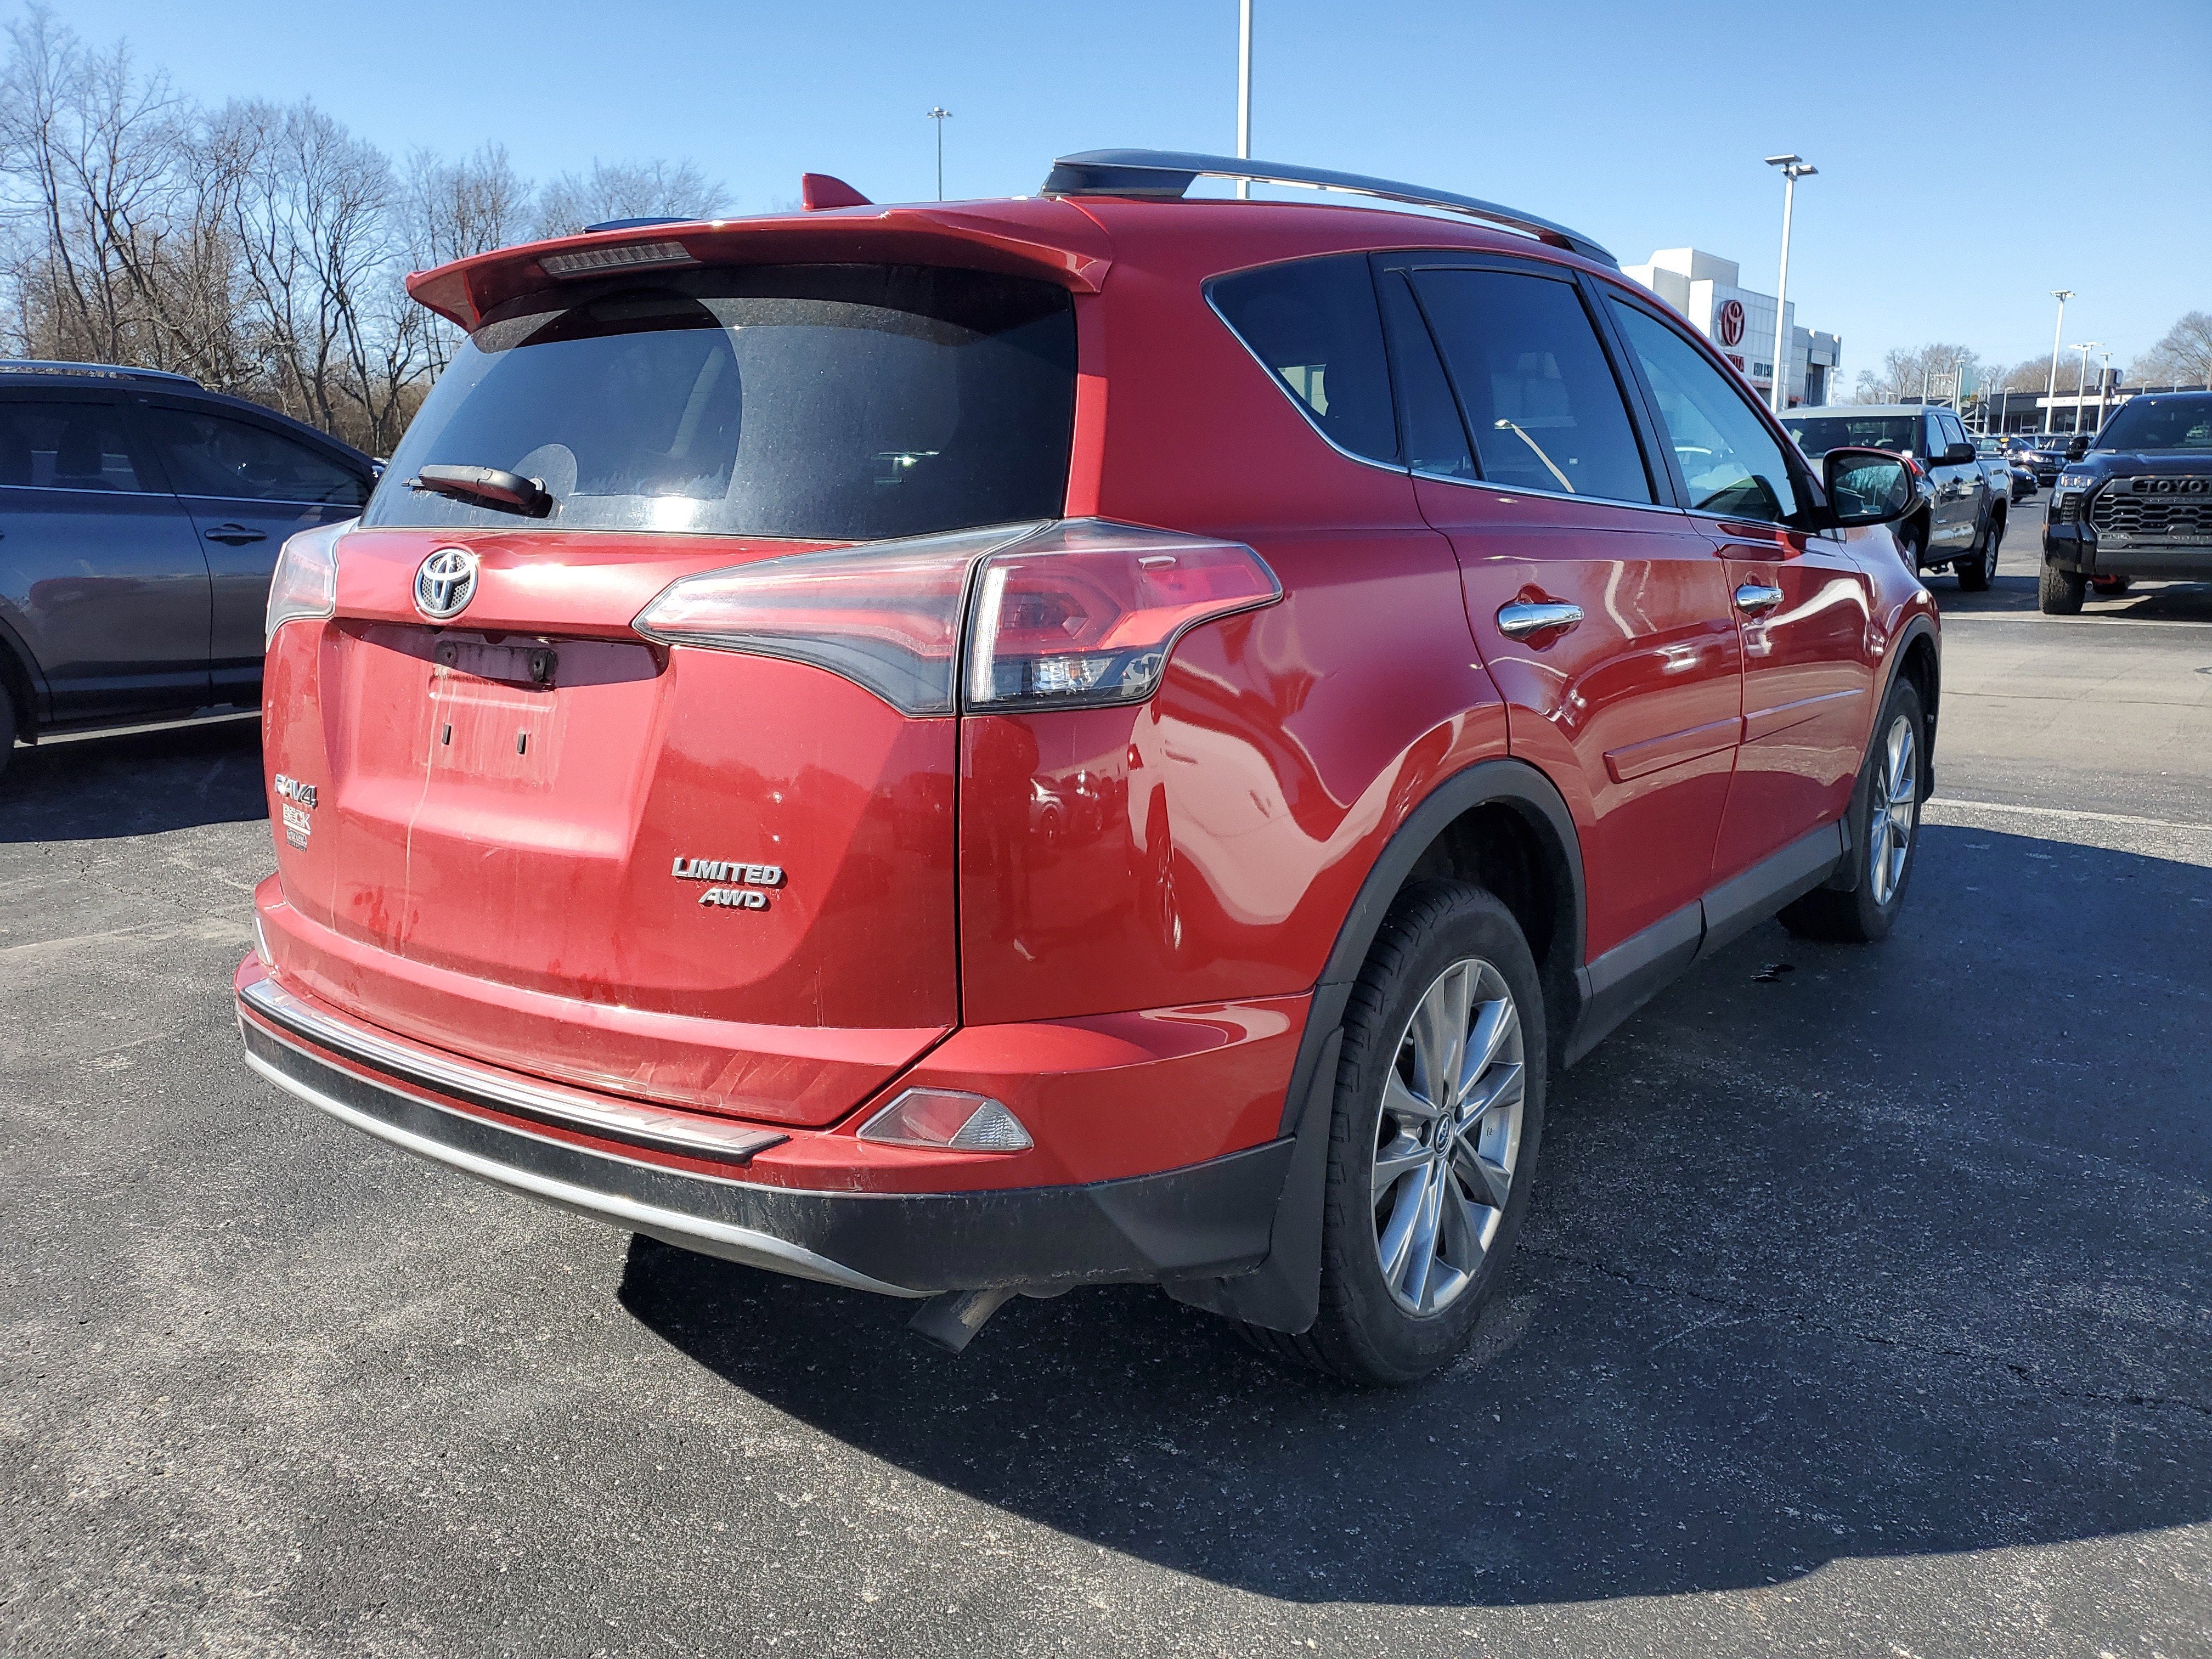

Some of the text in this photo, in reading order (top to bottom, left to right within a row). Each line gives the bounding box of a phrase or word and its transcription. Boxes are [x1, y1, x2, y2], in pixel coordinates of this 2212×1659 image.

[275, 774, 317, 809] RAV4
[283, 803, 311, 830] BECK
[672, 857, 783, 885] LIMITED
[698, 888, 766, 908] AWD
